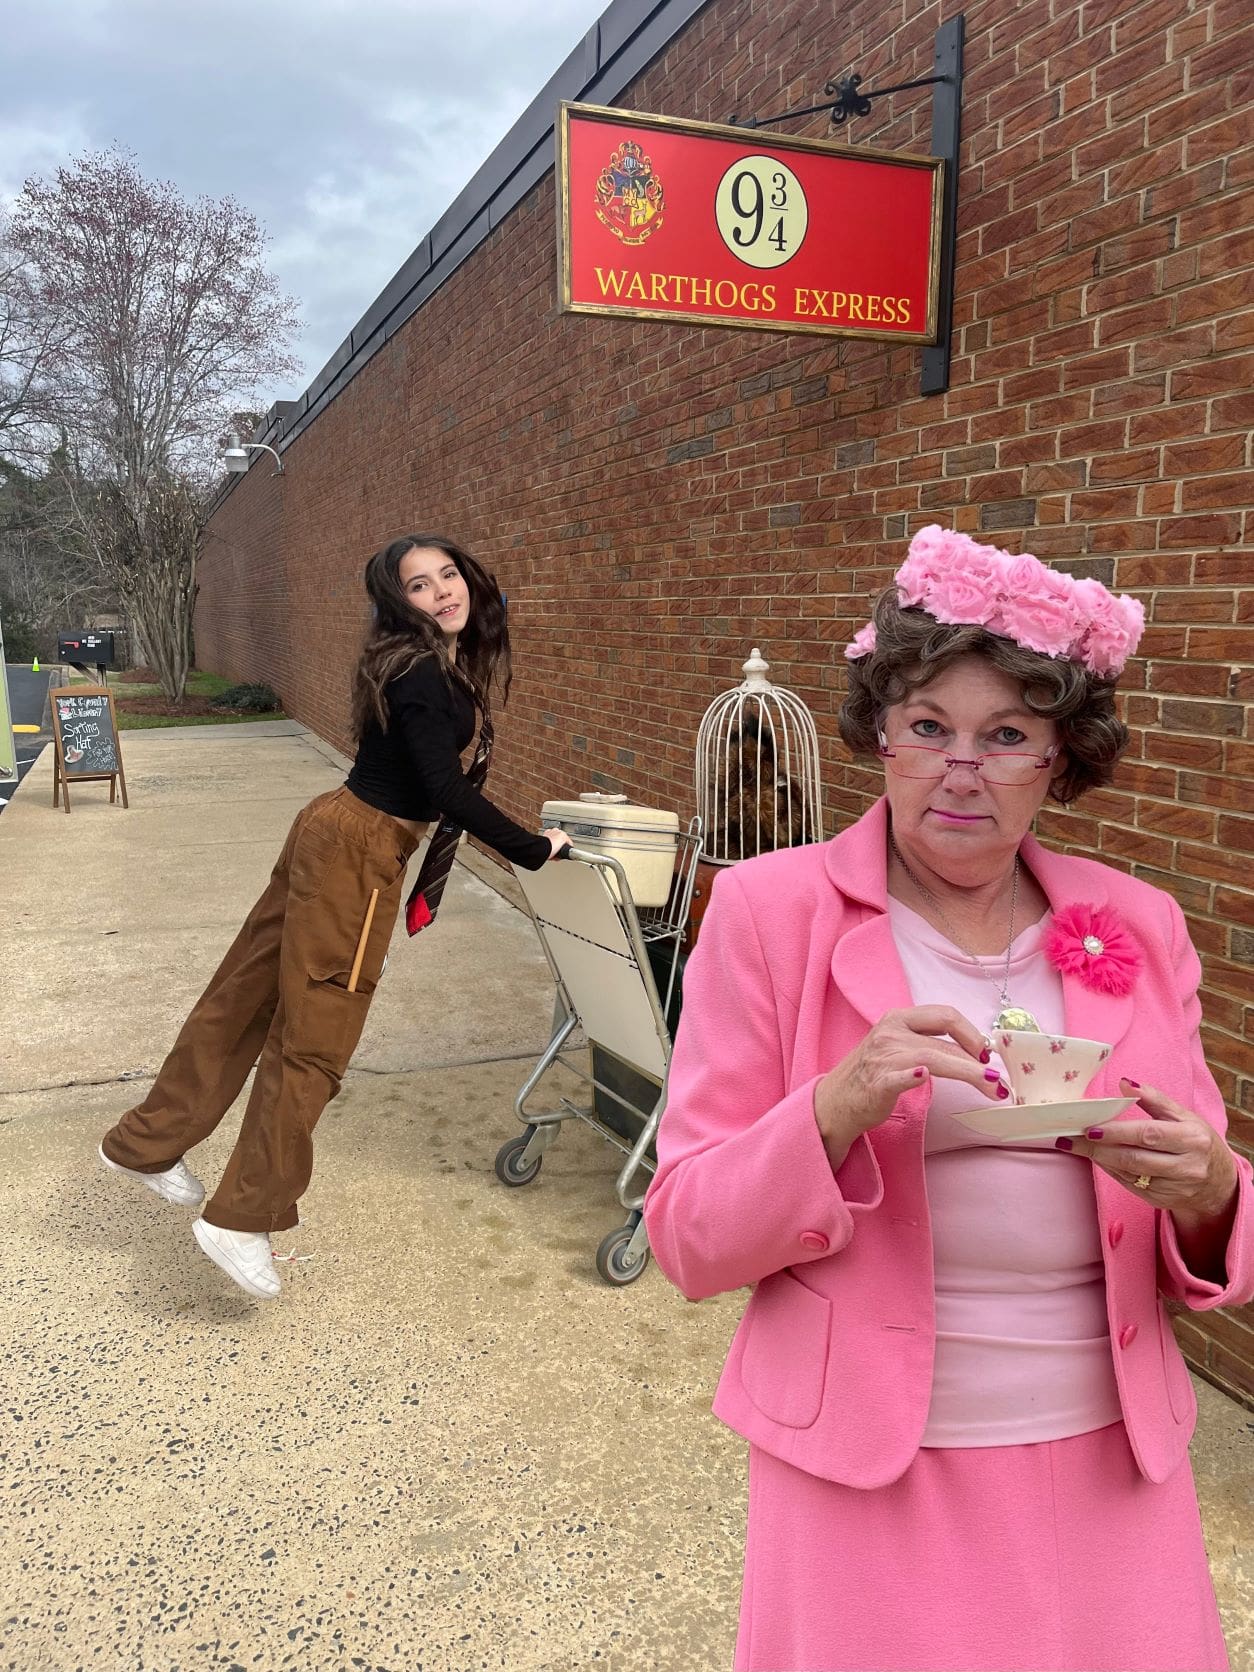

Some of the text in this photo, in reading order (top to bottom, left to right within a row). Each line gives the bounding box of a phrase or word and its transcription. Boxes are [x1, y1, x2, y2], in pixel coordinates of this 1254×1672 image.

[731, 171, 764, 247] 9
[594, 267, 911, 324] WARTHOGS EXPRESS
[62, 721, 100, 741] Sorting
[75, 734, 92, 752] Hat
